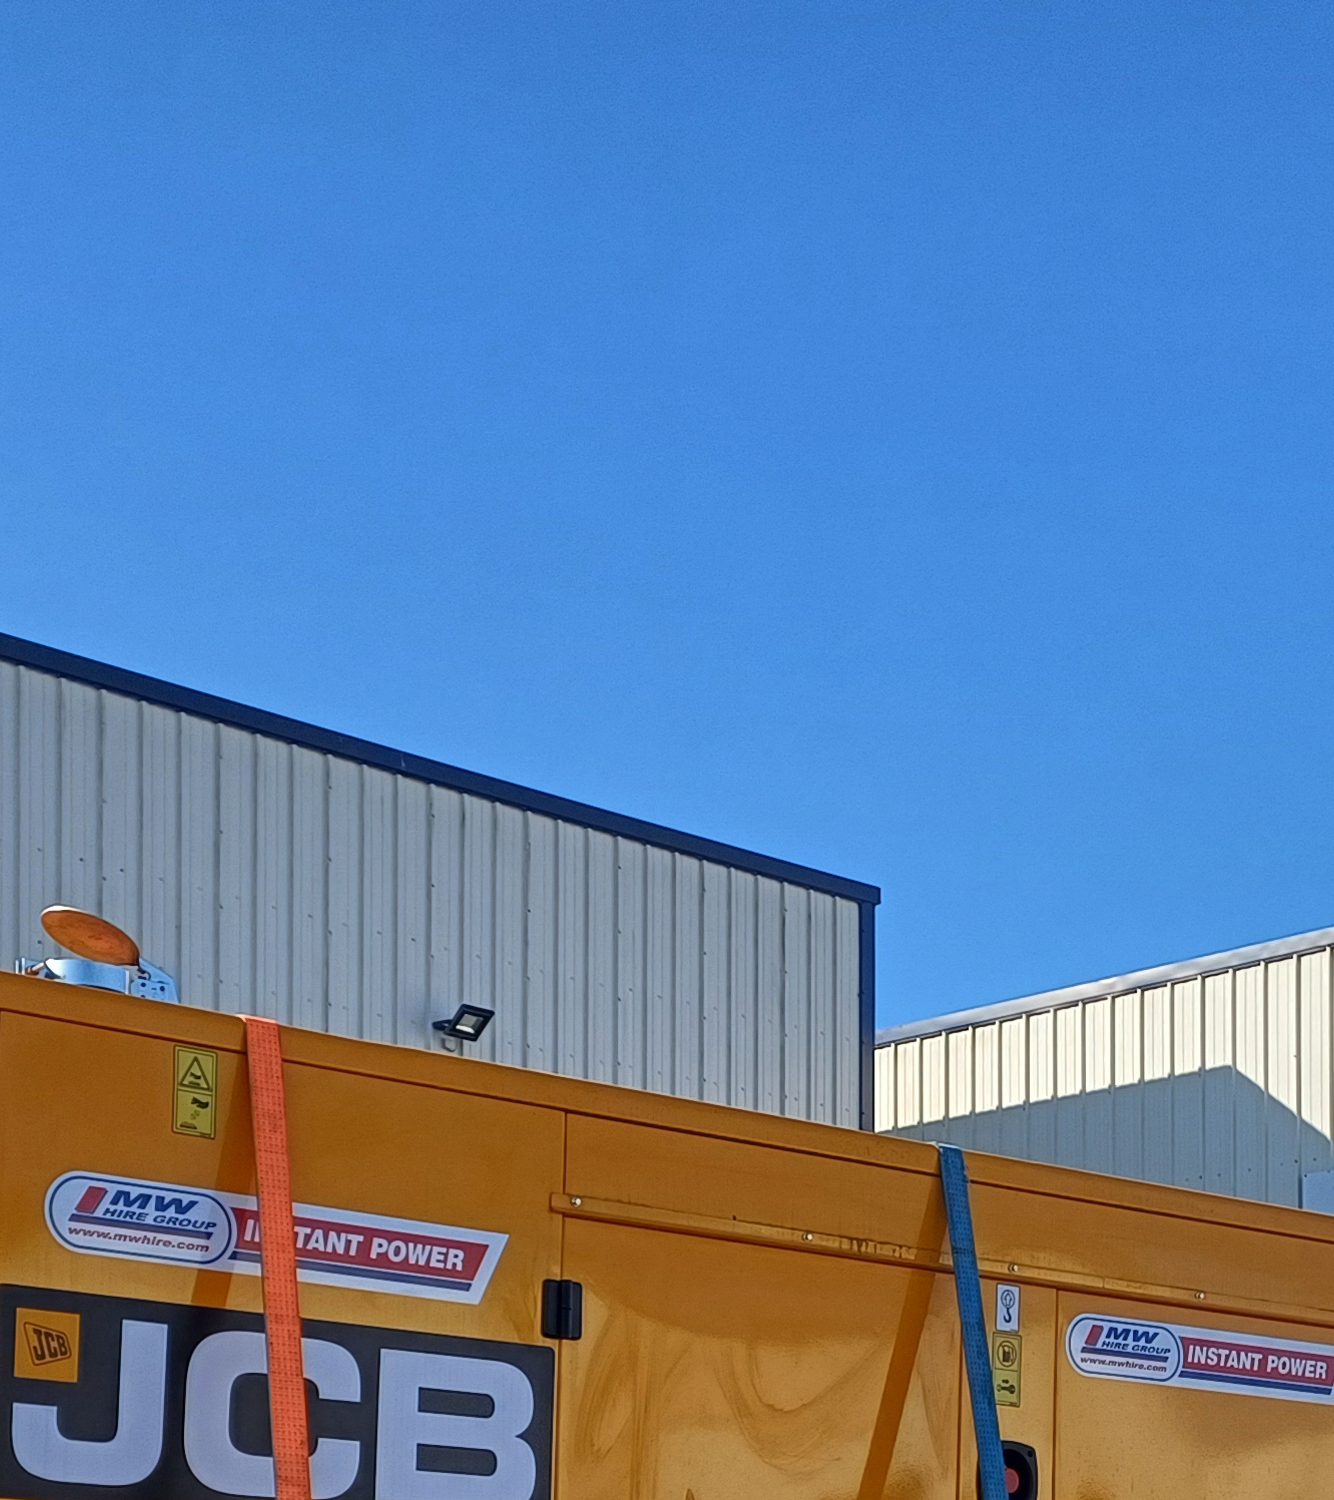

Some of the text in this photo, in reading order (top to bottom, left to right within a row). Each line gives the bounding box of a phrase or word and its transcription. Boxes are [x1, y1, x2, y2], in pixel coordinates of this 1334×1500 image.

[109, 1190, 200, 1215] MW
[102, 1207, 217, 1231] HIRE GROUP
[68, 1226, 210, 1253] www.mwhire.com
[243, 1218, 465, 1272] ITANT POWER
[32, 1327, 68, 1361] JCB
[1101, 1340, 1171, 1355] HIRE GROUP
[1104, 1326, 1160, 1344] MW
[1080, 1356, 1167, 1373] www.mwhire.com
[1187, 1344, 1327, 1380] INSTANT POWER
